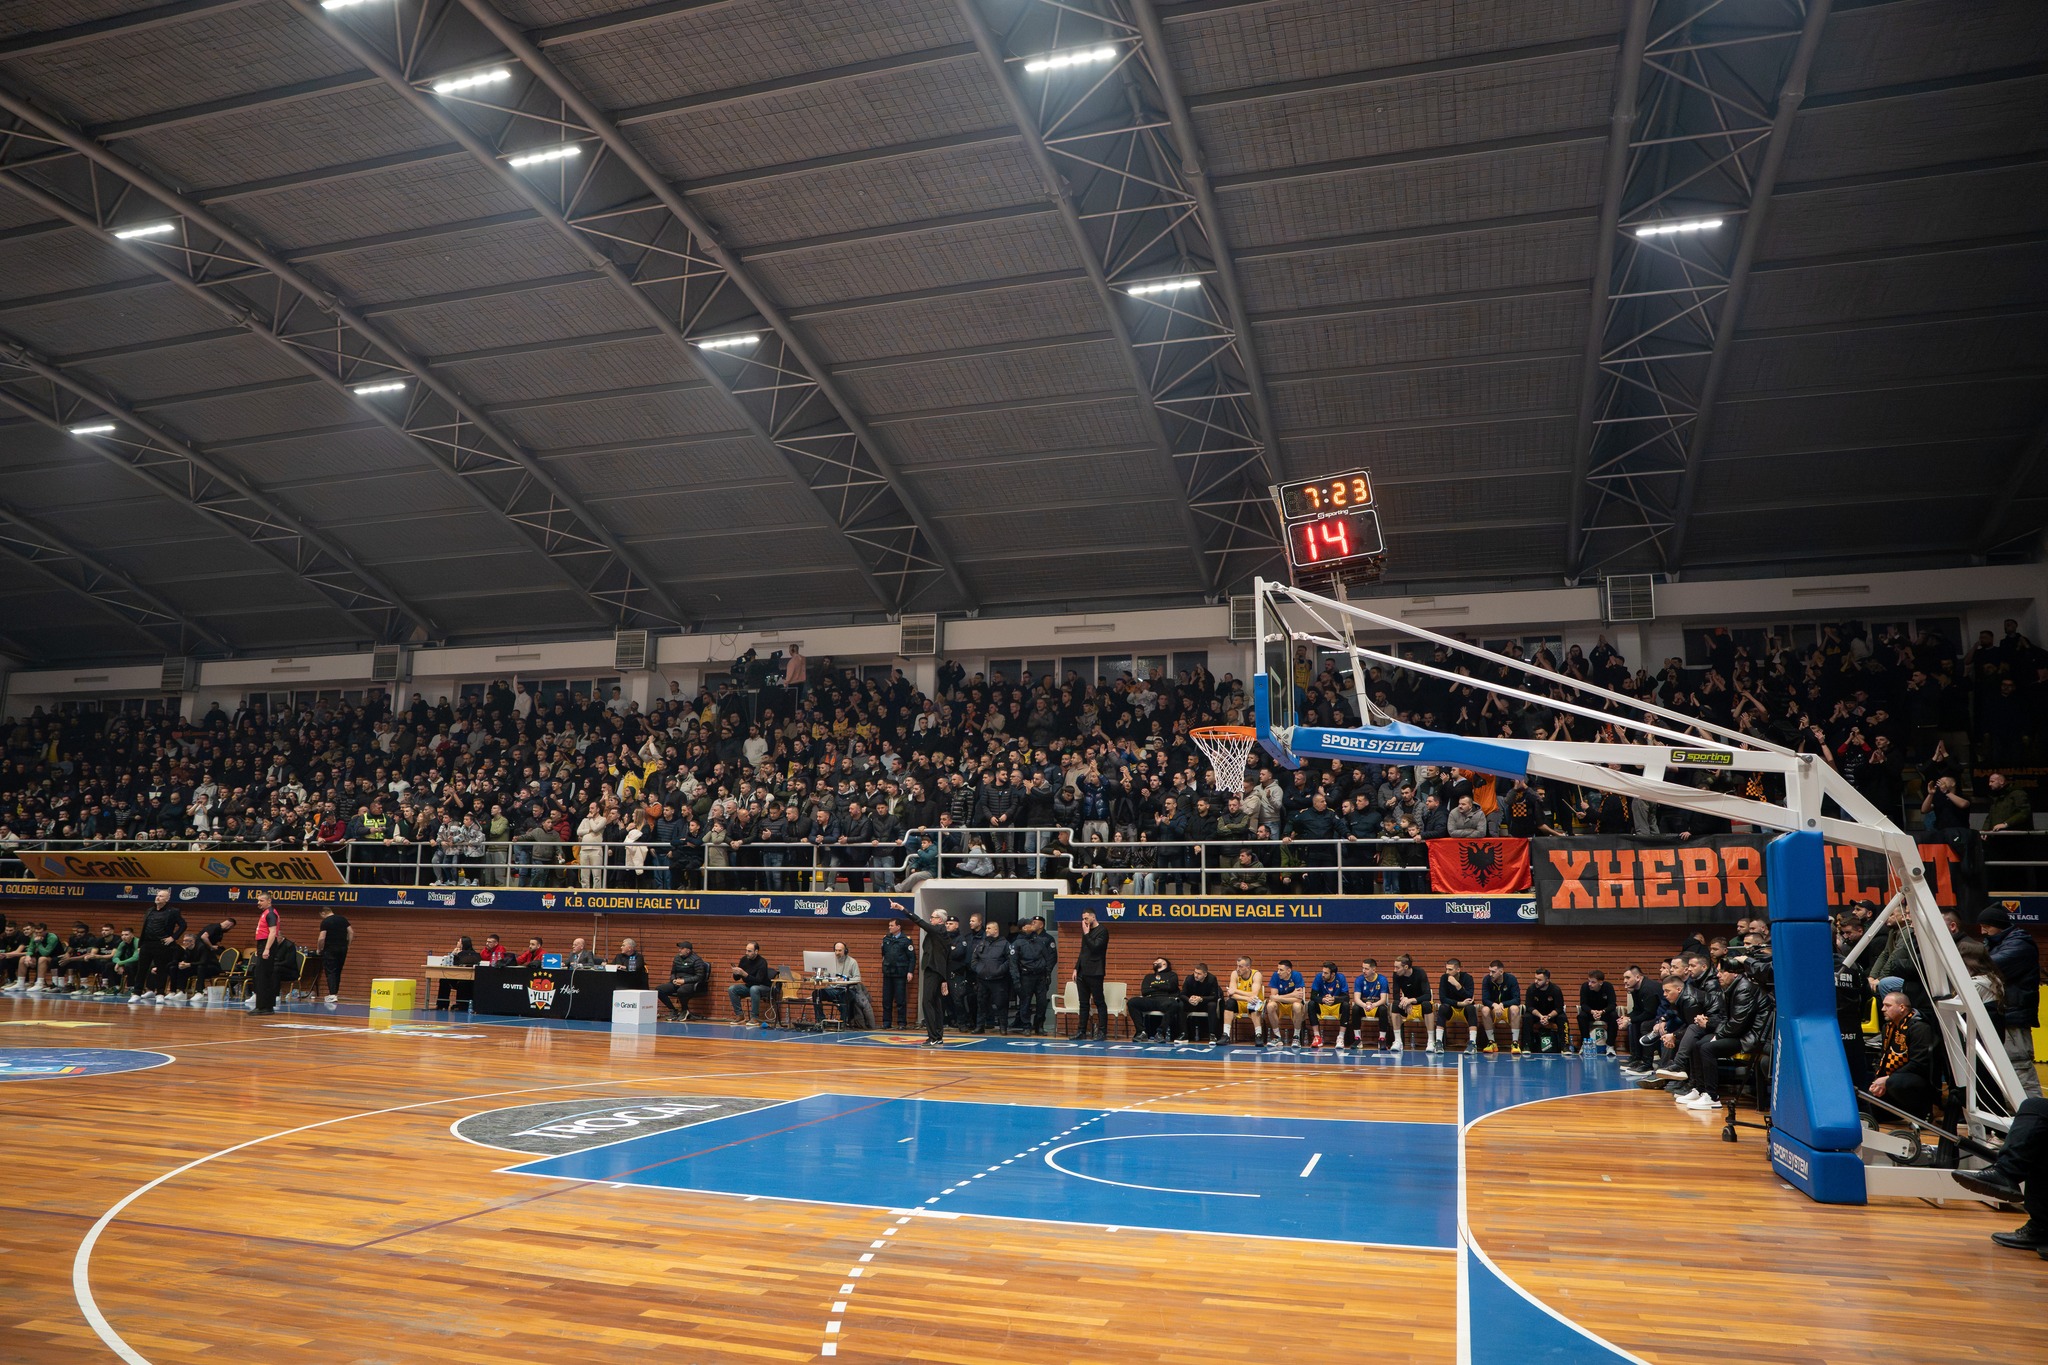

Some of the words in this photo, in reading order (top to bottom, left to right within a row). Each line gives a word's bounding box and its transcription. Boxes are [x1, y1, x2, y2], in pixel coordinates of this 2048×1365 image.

[1304, 478, 1367, 508] 7:23
[1324, 509, 1348, 518] sporting
[1308, 522, 1348, 560] 14
[1687, 752, 1730, 764] sporting
[65, 856, 150, 878] Graniti
[230, 856, 322, 880] Graniti
[1549, 845, 1960, 909] XHEBRILT
[6, 884, 38, 894] GOLDEN
[40, 886, 66, 895] EAGLE
[67, 886, 84, 896] YLLI
[306, 891, 335, 901] EAGLE
[337, 892, 358, 902] YLLI
[474, 894, 492, 904] Relax
[564, 896, 585, 908] K.B.
[588, 896, 633, 908] GOLDEN
[636, 898, 672, 909] EAGLE
[675, 898, 700, 910] YLLI
[794, 900, 828, 909] Natural
[845, 901, 867, 912] Relax
[1446, 902, 1490, 913] Natural
[1138, 904, 1166, 916] K.B.
[1170, 904, 1231, 917] GOLDEN
[1236, 904, 1284, 917] EAGLE
[1289, 904, 1322, 917] YLLI
[532, 978, 551, 990] 50
[533, 991, 550, 1001] YLLI
[1006, 1041, 1213, 1053] GOLDEN
[1230, 1048, 1398, 1058] EAGLE
